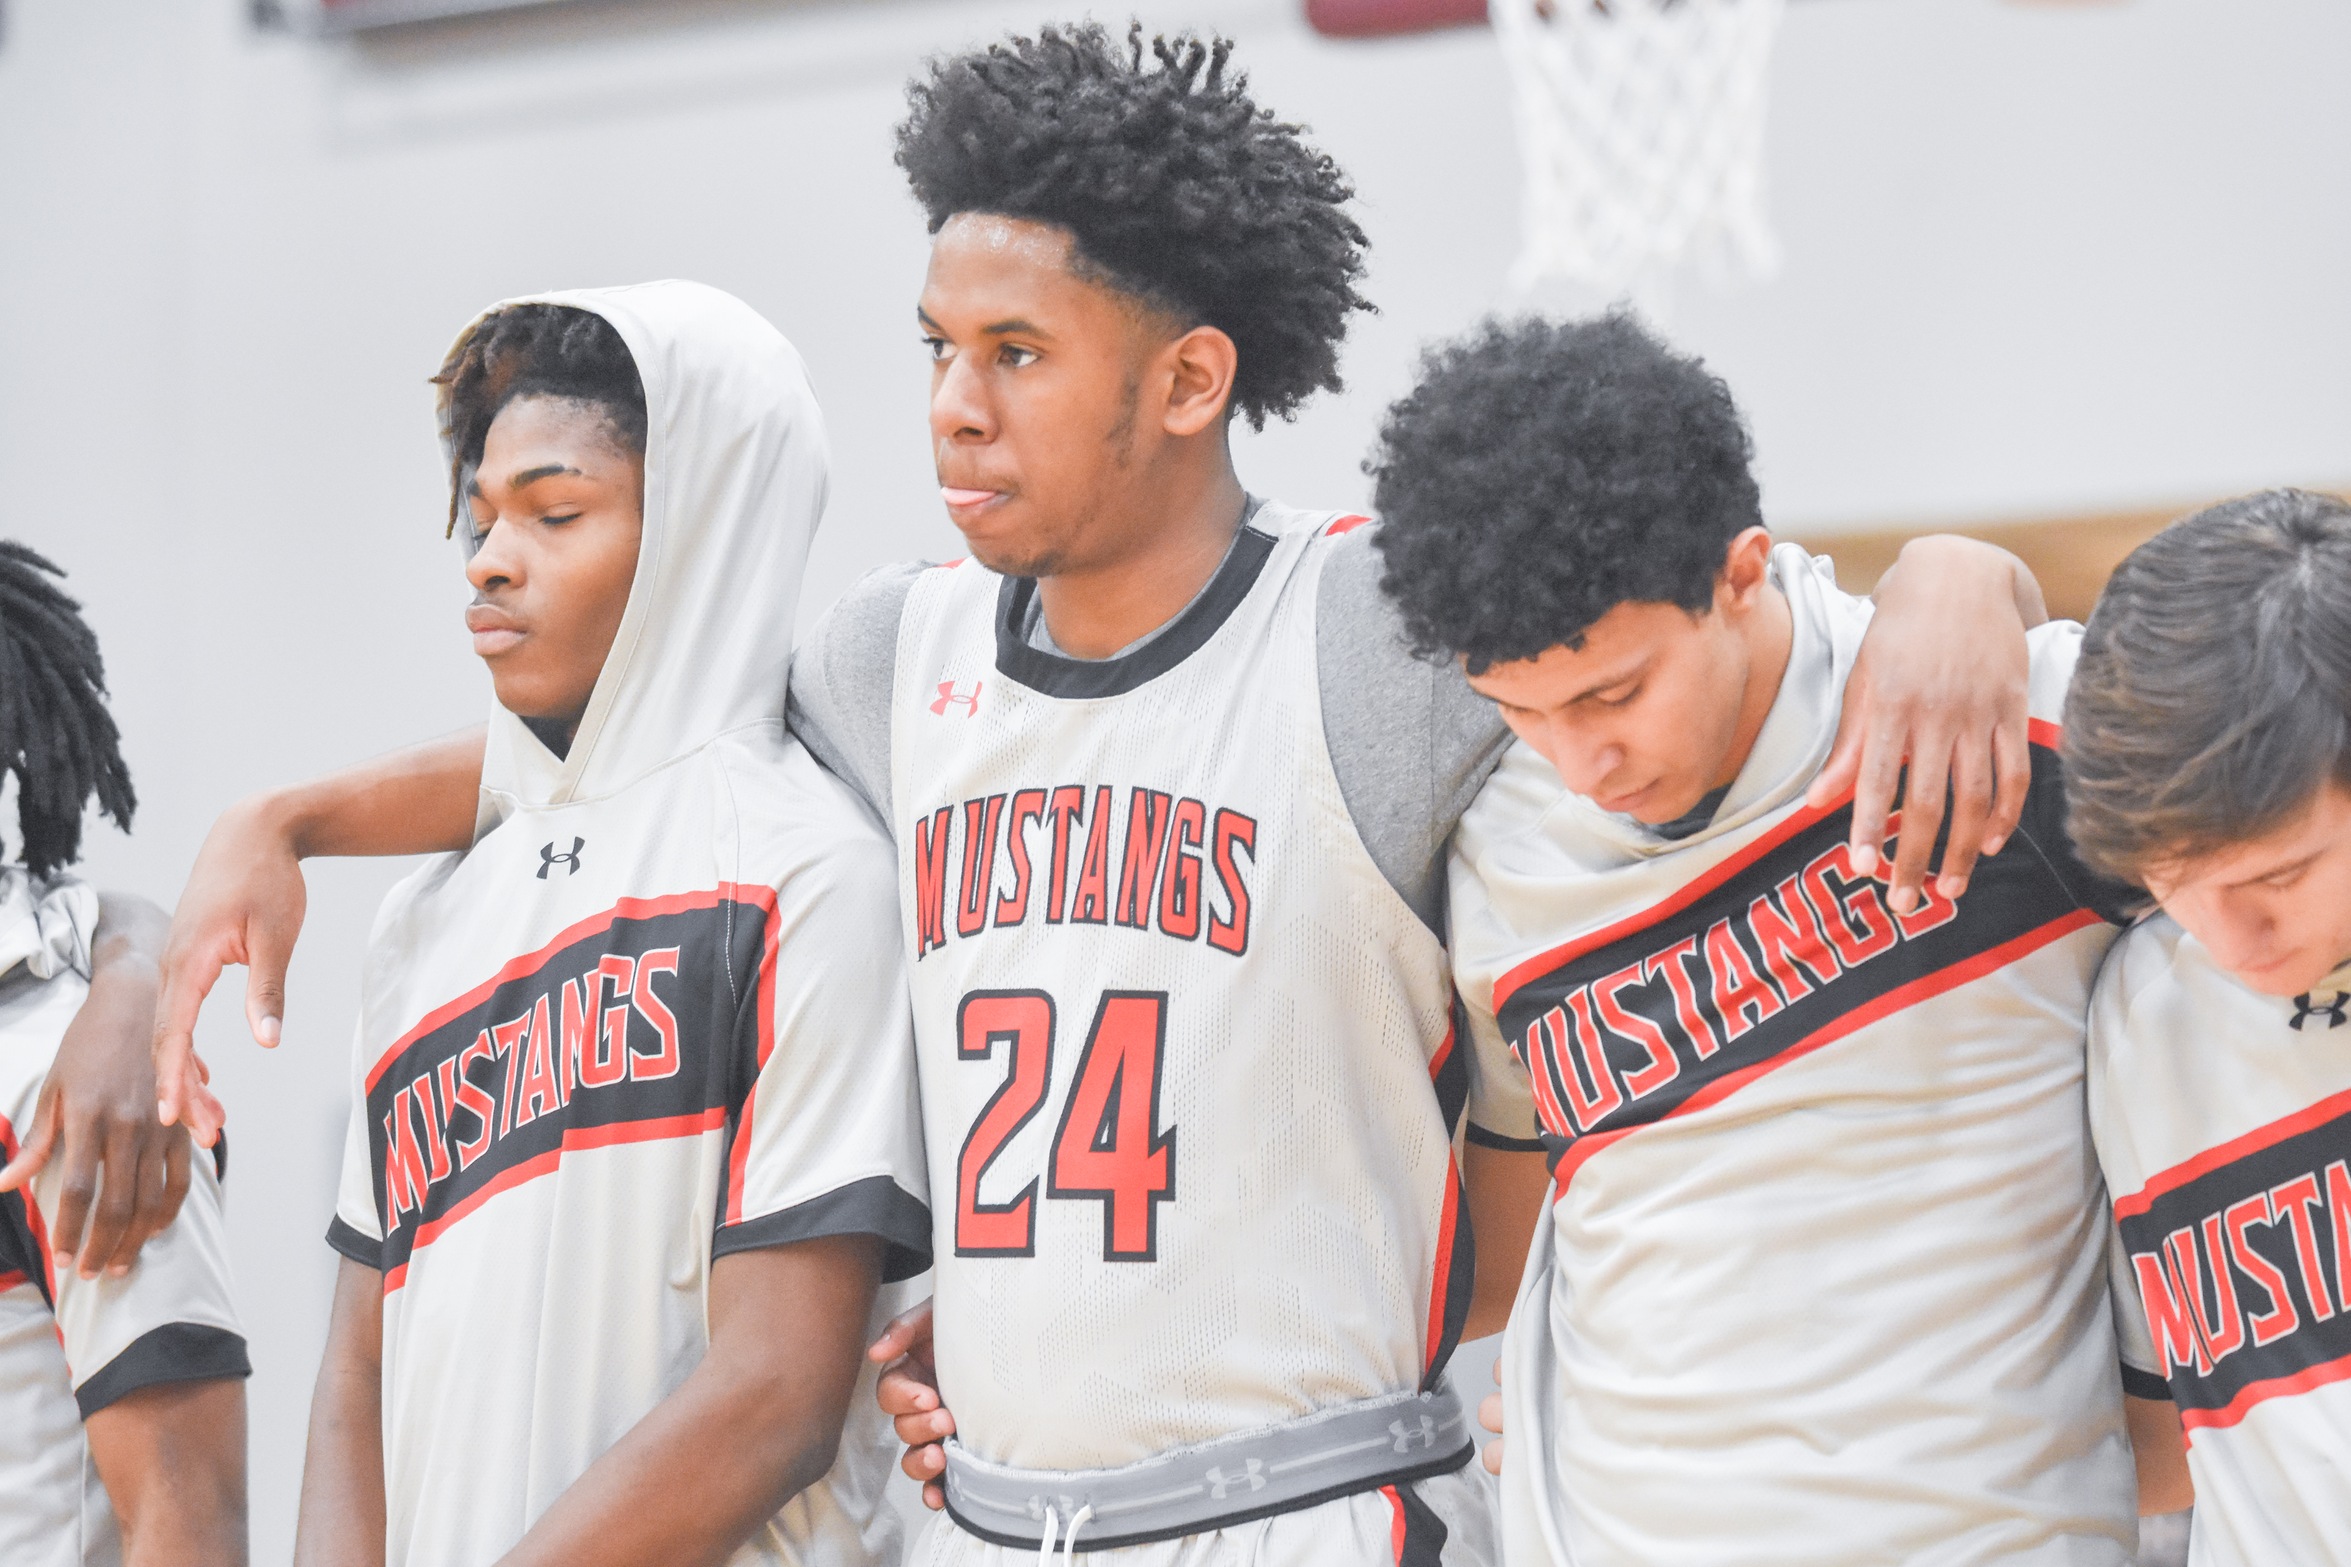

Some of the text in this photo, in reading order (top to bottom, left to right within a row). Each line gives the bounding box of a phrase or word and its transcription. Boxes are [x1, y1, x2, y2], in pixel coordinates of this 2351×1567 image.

[915, 784, 1258, 961] MUSTANGS
[383, 945, 681, 1238] MUSTANGS
[955, 989, 1177, 1262] 24
